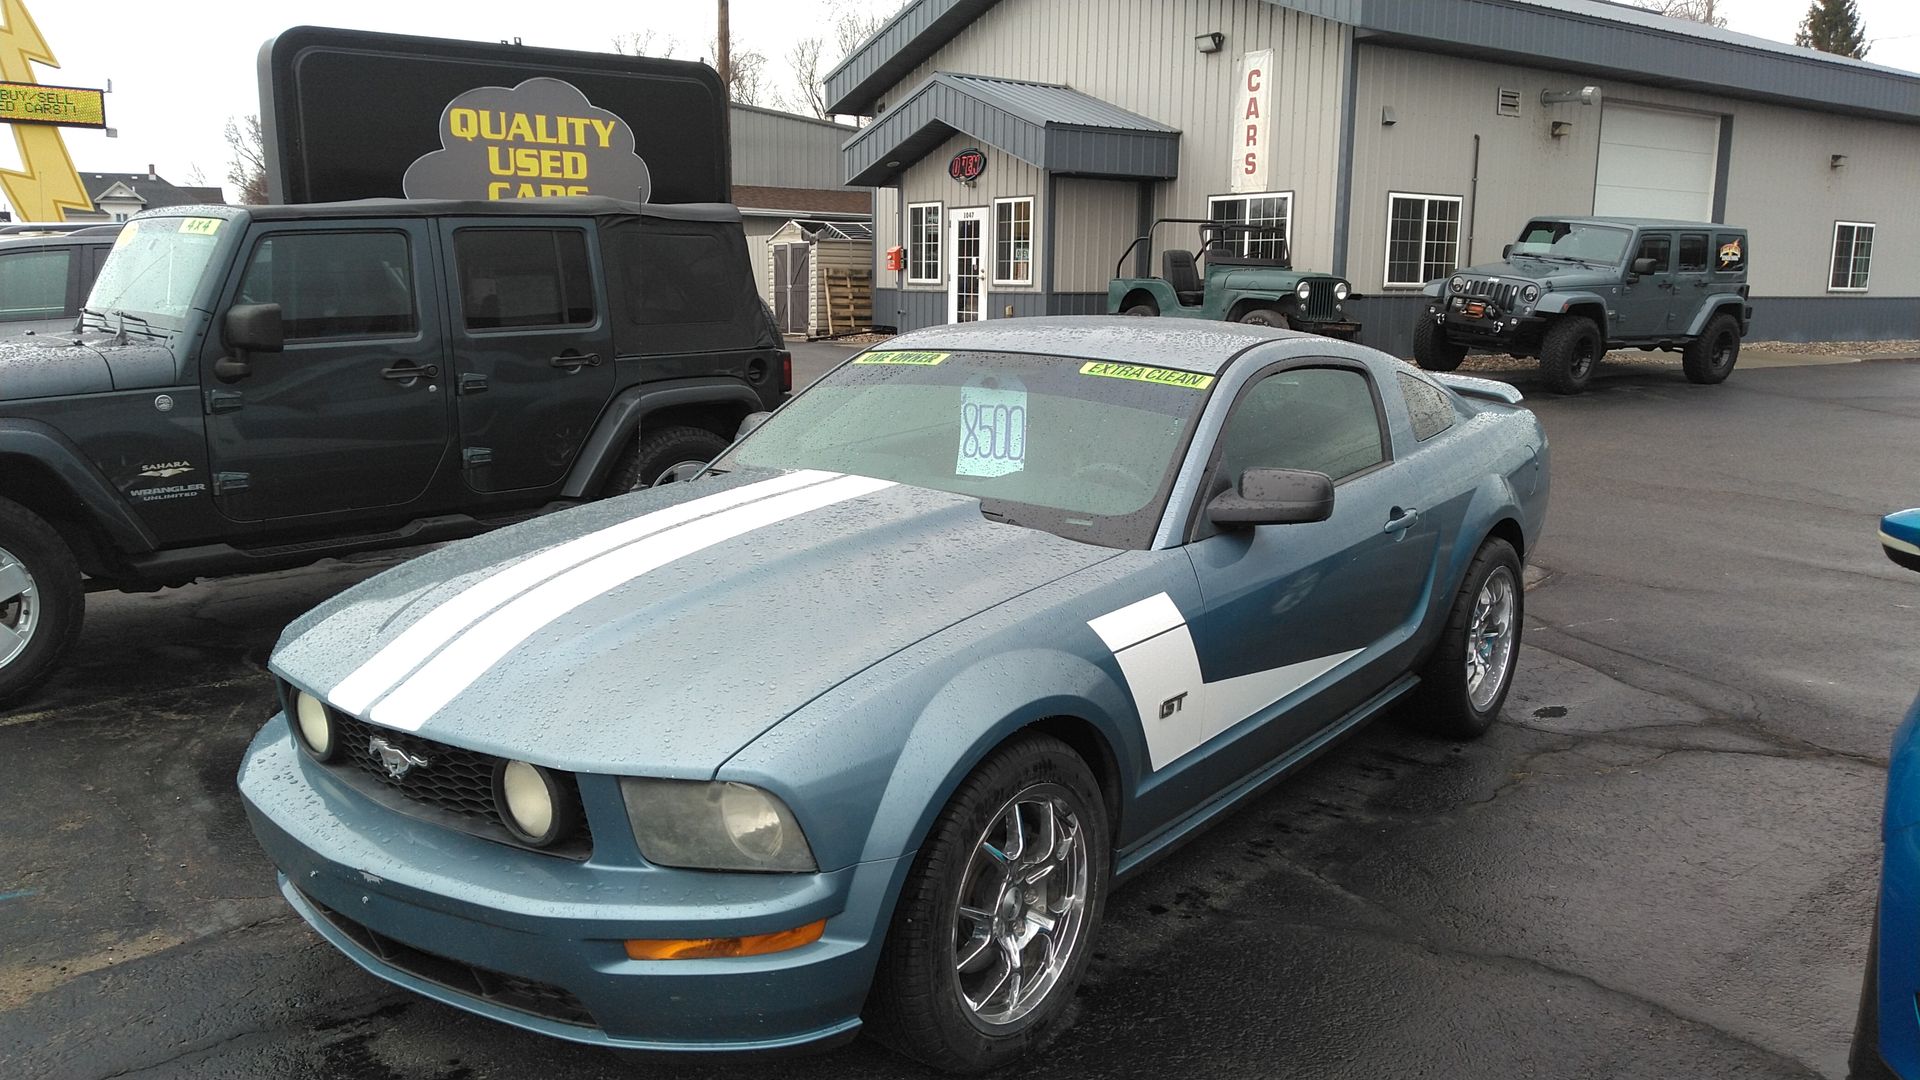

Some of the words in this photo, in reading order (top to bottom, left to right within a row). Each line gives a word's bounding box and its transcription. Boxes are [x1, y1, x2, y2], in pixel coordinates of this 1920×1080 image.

[450, 107, 615, 148] QUALITY
[1244, 69, 1261, 175] CARS
[487, 146, 588, 180] USED
[1087, 363, 1144, 378] EXTRA
[1145, 369, 1205, 386] CLEAN
[962, 402, 1025, 461] 8500
[141, 460, 191, 471] SAHARA
[130, 483, 206, 497] WRANGLER
[143, 491, 198, 501] UNLIMITED
[1158, 690, 1189, 720] GT
